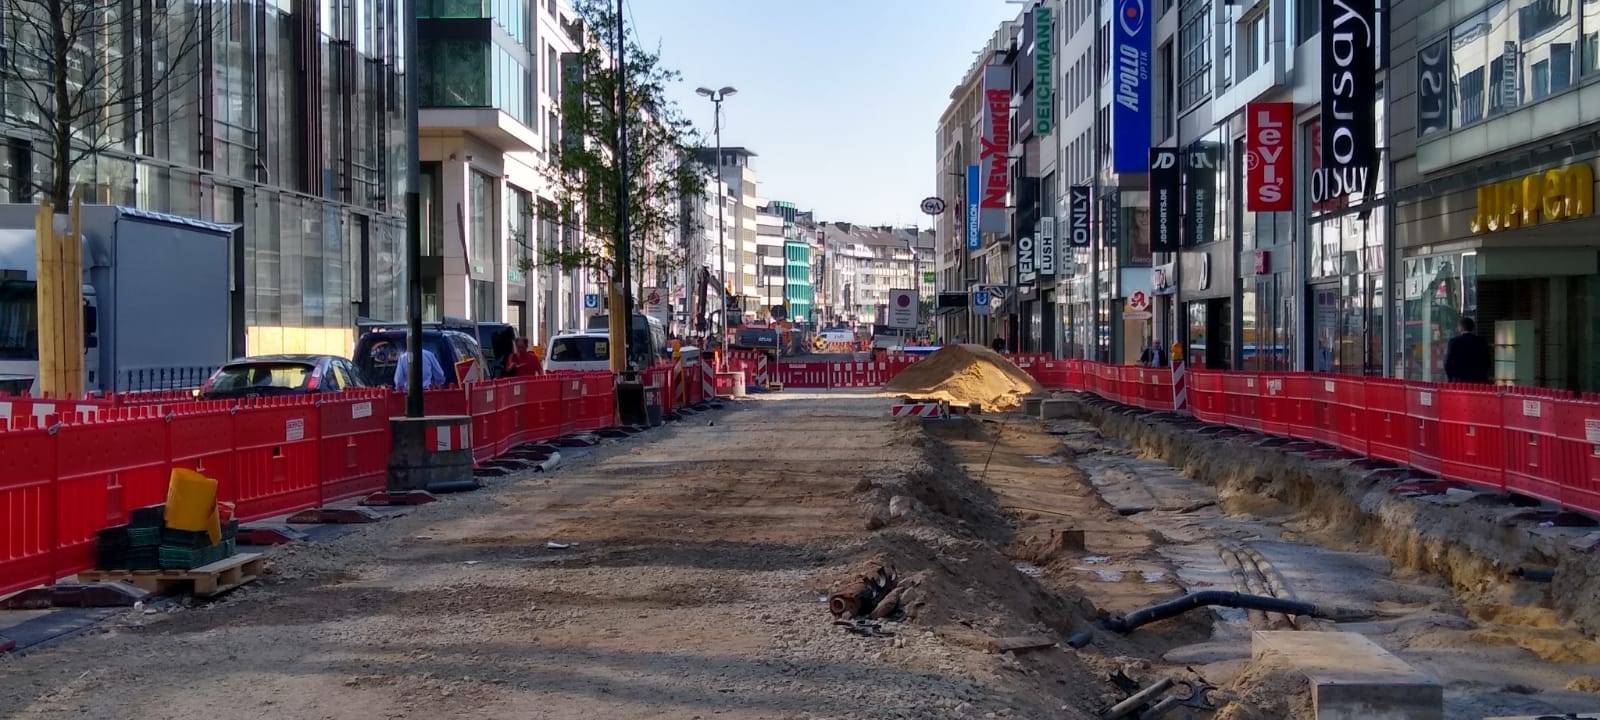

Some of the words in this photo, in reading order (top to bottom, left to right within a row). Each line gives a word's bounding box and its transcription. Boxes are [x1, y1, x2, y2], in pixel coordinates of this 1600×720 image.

[1037, 9, 1050, 132] DEICHMANN
[1117, 44, 1139, 112] APOLLO
[1140, 51, 1148, 80] OPTIK
[1333, 0, 1371, 164] orsay
[1152, 152, 1176, 169] JD
[1073, 190, 1087, 244] ONLY
[1019, 236, 1036, 284] RENO
[1043, 237, 1052, 271] LUSH
[586, 294, 597, 308] U
